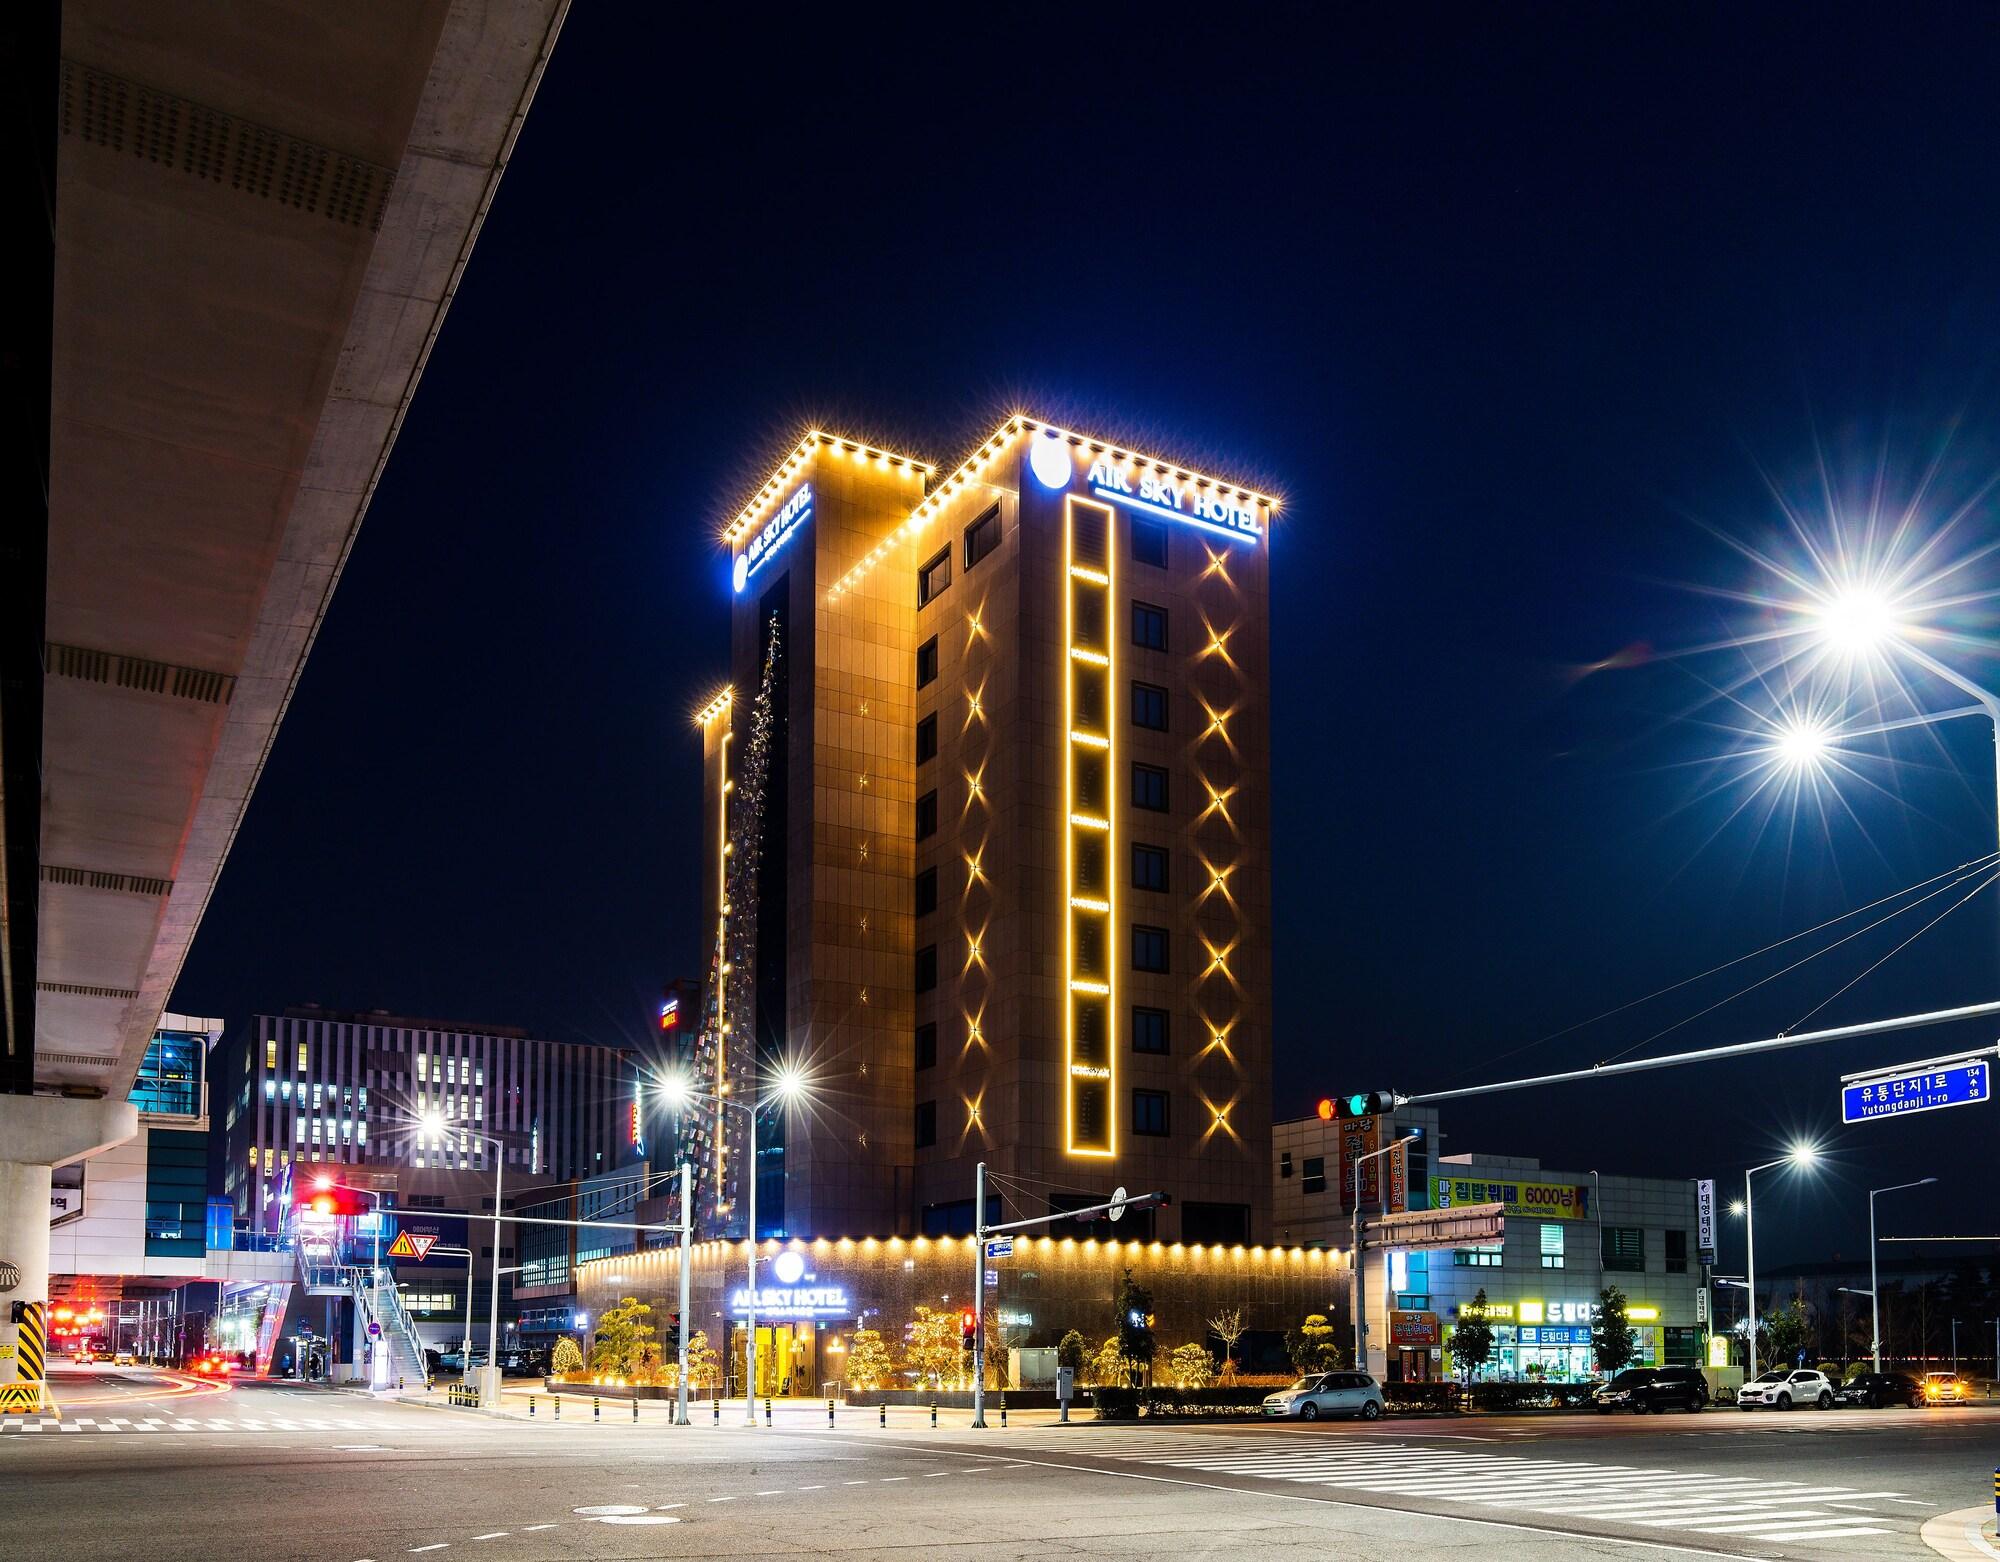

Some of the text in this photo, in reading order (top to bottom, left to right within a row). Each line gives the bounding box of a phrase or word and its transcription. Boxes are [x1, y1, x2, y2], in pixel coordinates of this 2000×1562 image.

[1088, 460, 1263, 535] AIR SKY HOTEL
[747, 535, 764, 565] AIR
[763, 513, 781, 548] SKY
[780, 483, 812, 529] HOTEL
[1966, 1067, 1980, 1078] 134
[1861, 1074, 1948, 1103] 유통단지1로
[1969, 1088, 1979, 1097] 58
[1861, 1093, 1949, 1116] Yutongdanji 1-ro
[1343, 1119, 1373, 1131] 마당
[1455, 1182, 1574, 1207] 집밥뷔페 6000냥
[1701, 1193, 1713, 1246] 대영테이프
[794, 1288, 848, 1306] HOTEL
[1541, 1331, 1570, 1343] 드림디포
